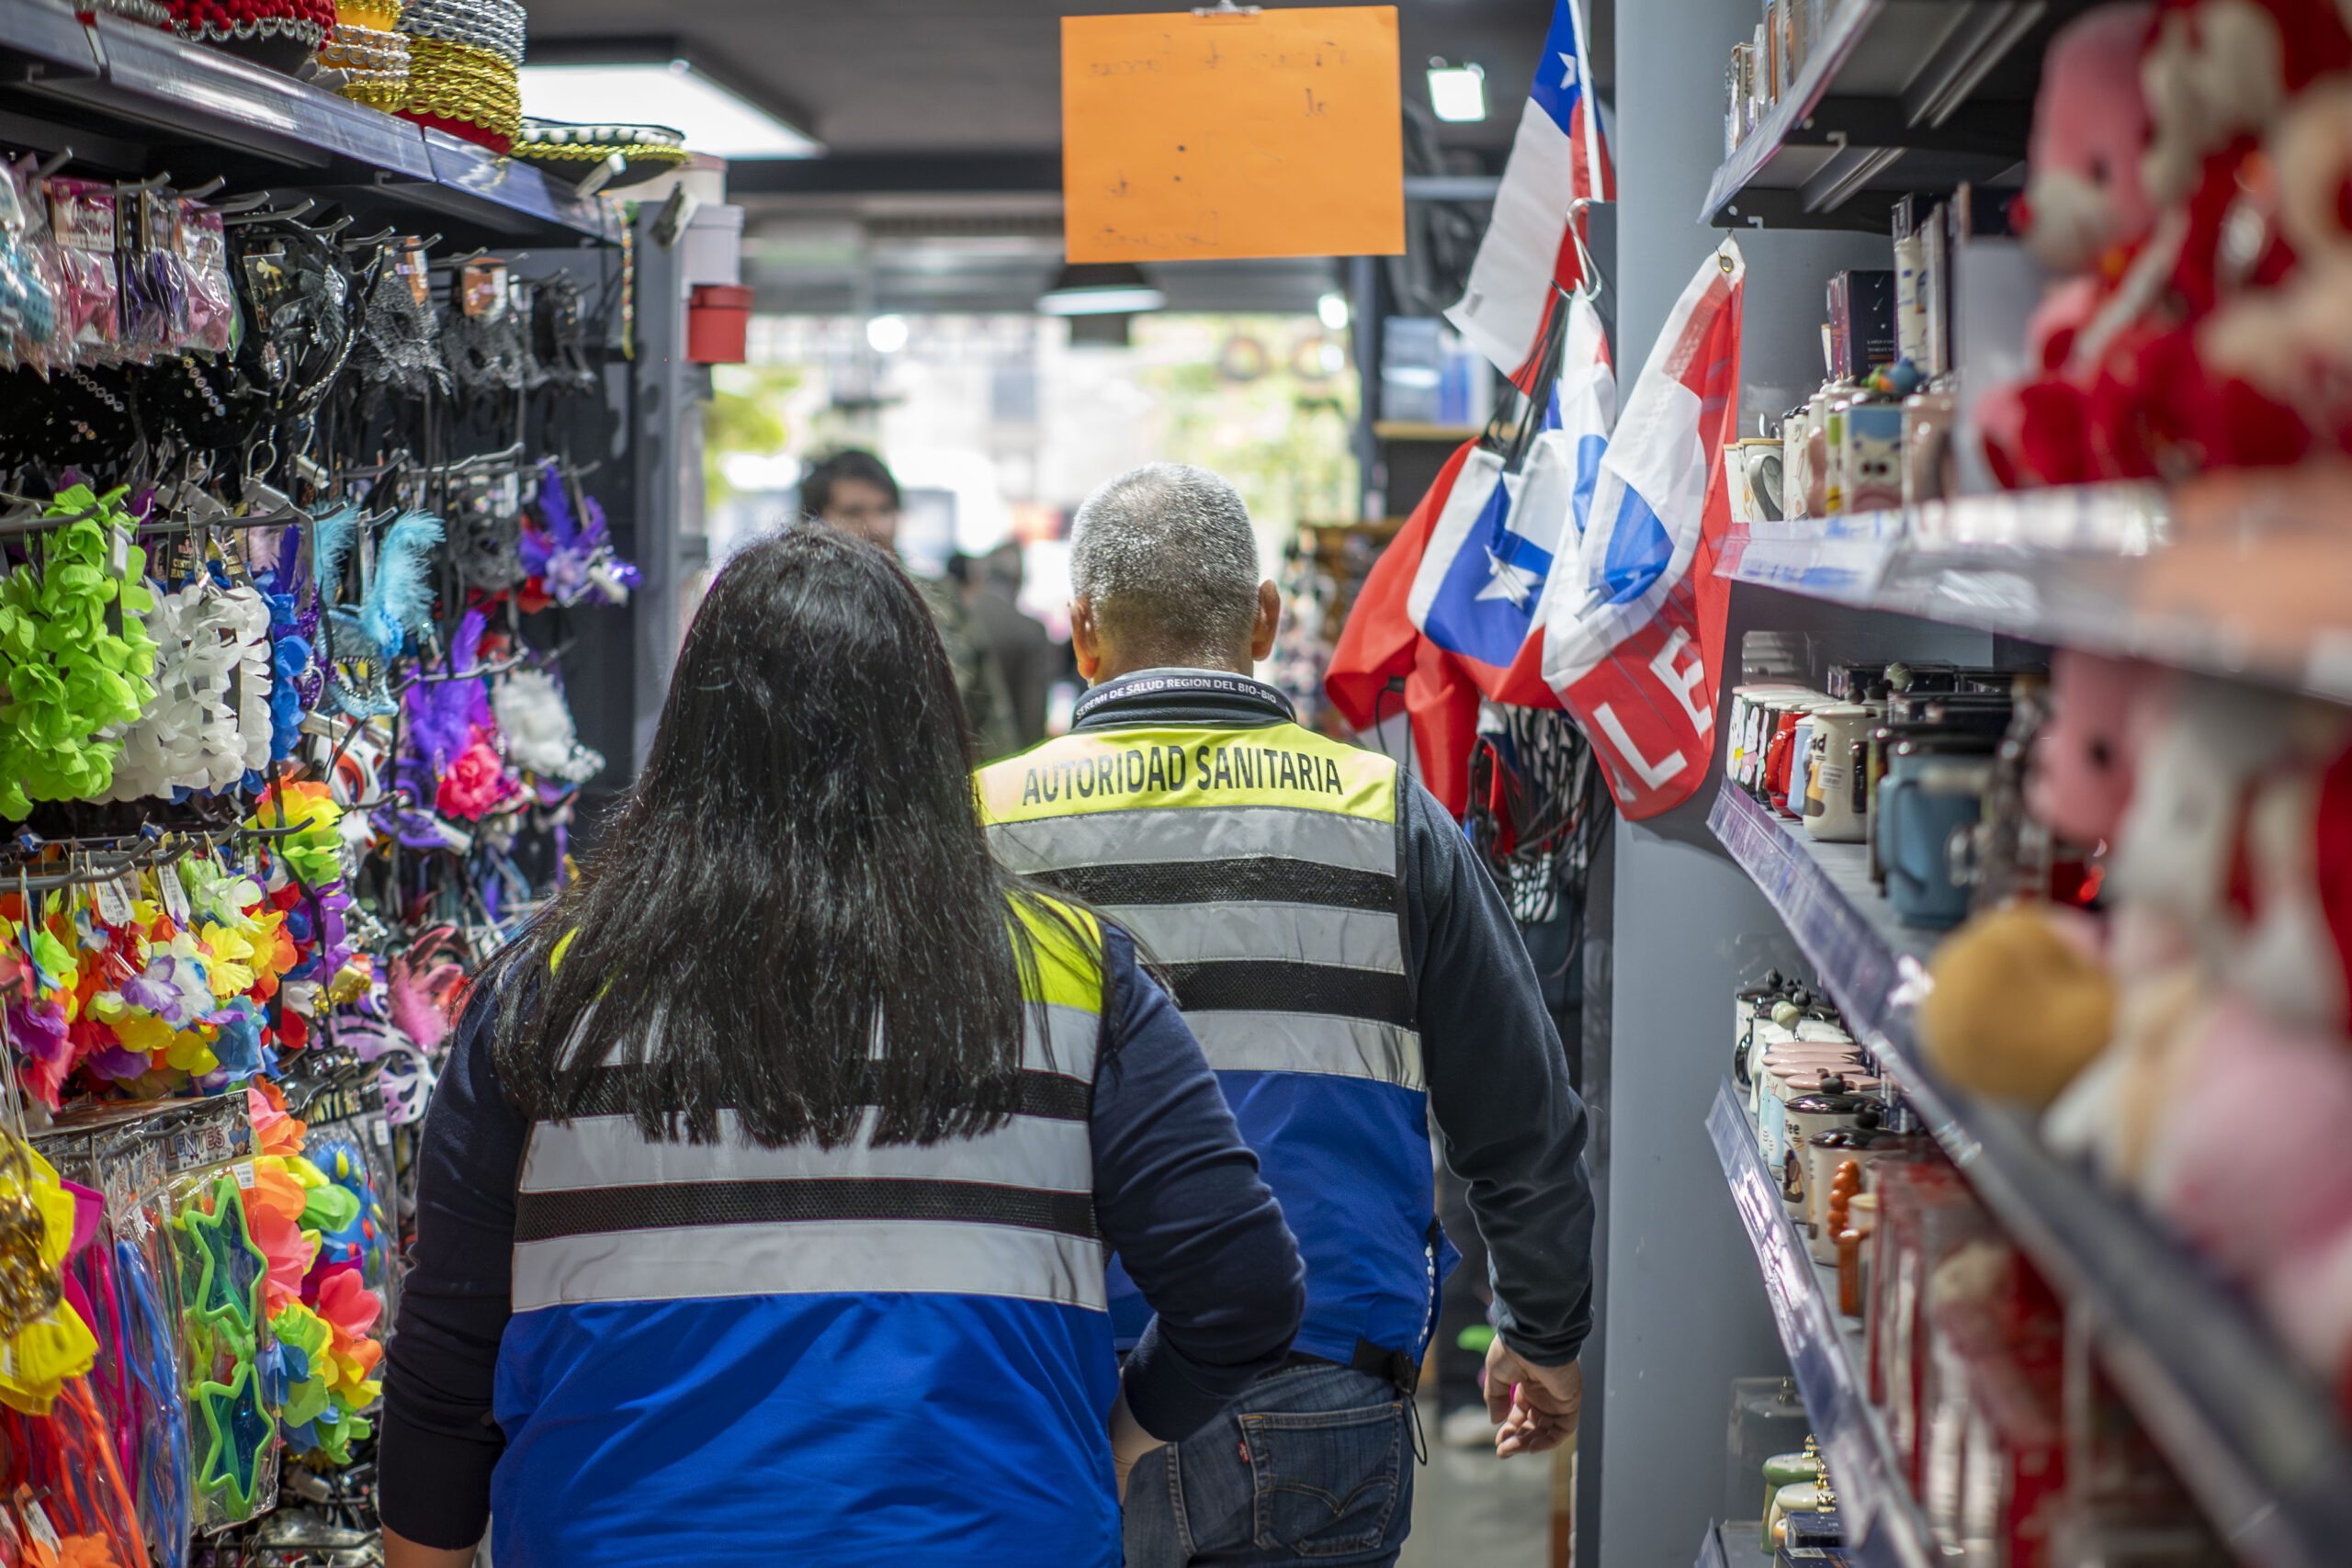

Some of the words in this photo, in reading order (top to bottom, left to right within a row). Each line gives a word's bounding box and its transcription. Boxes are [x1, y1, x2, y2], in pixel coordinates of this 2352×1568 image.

[1076, 693, 1108, 720] SEREMI
[1109, 688, 1125, 700] DE
[1126, 680, 1164, 695] SALUD
[1166, 678, 1213, 688] REGION
[1216, 679, 1236, 691] DEL
[1022, 745, 1186, 806] AUTORIDAD
[1195, 745, 1343, 795] SANITARIA
[165, 1126, 226, 1161] LENTES
